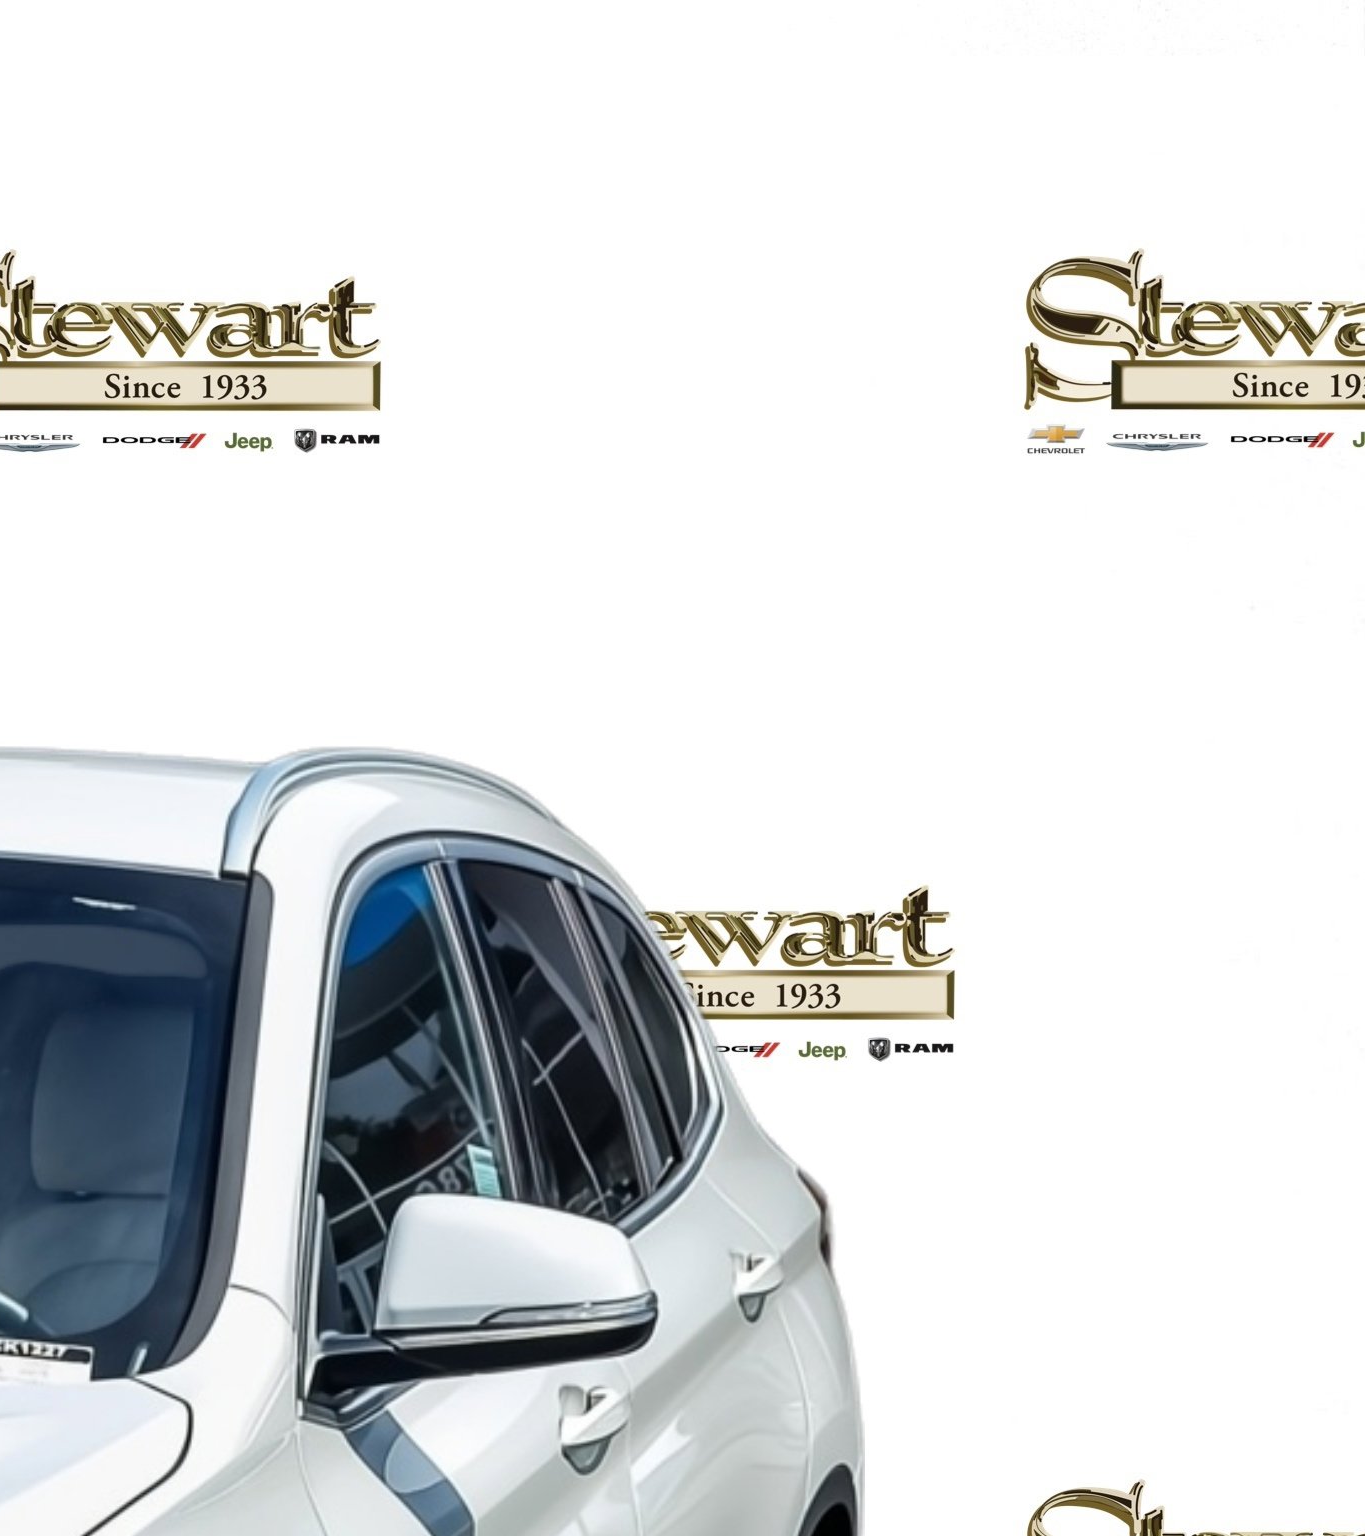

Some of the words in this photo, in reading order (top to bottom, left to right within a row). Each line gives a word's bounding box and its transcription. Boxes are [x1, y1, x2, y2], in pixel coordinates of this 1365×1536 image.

[104, 372, 181, 399] Since
[203, 373, 268, 400] 1933
[1232, 371, 1309, 398] Since
[1331, 372, 1365, 399] 19
[103, 436, 191, 444] DODGE
[224, 432, 273, 453] Jeep
[320, 434, 381, 445] RAM
[1112, 432, 1202, 440] CHRYSLER
[1231, 435, 1319, 443] DODGE
[777, 982, 842, 1009] 1933
[798, 1041, 847, 1062] Jeep
[894, 1043, 955, 1054] RAM
